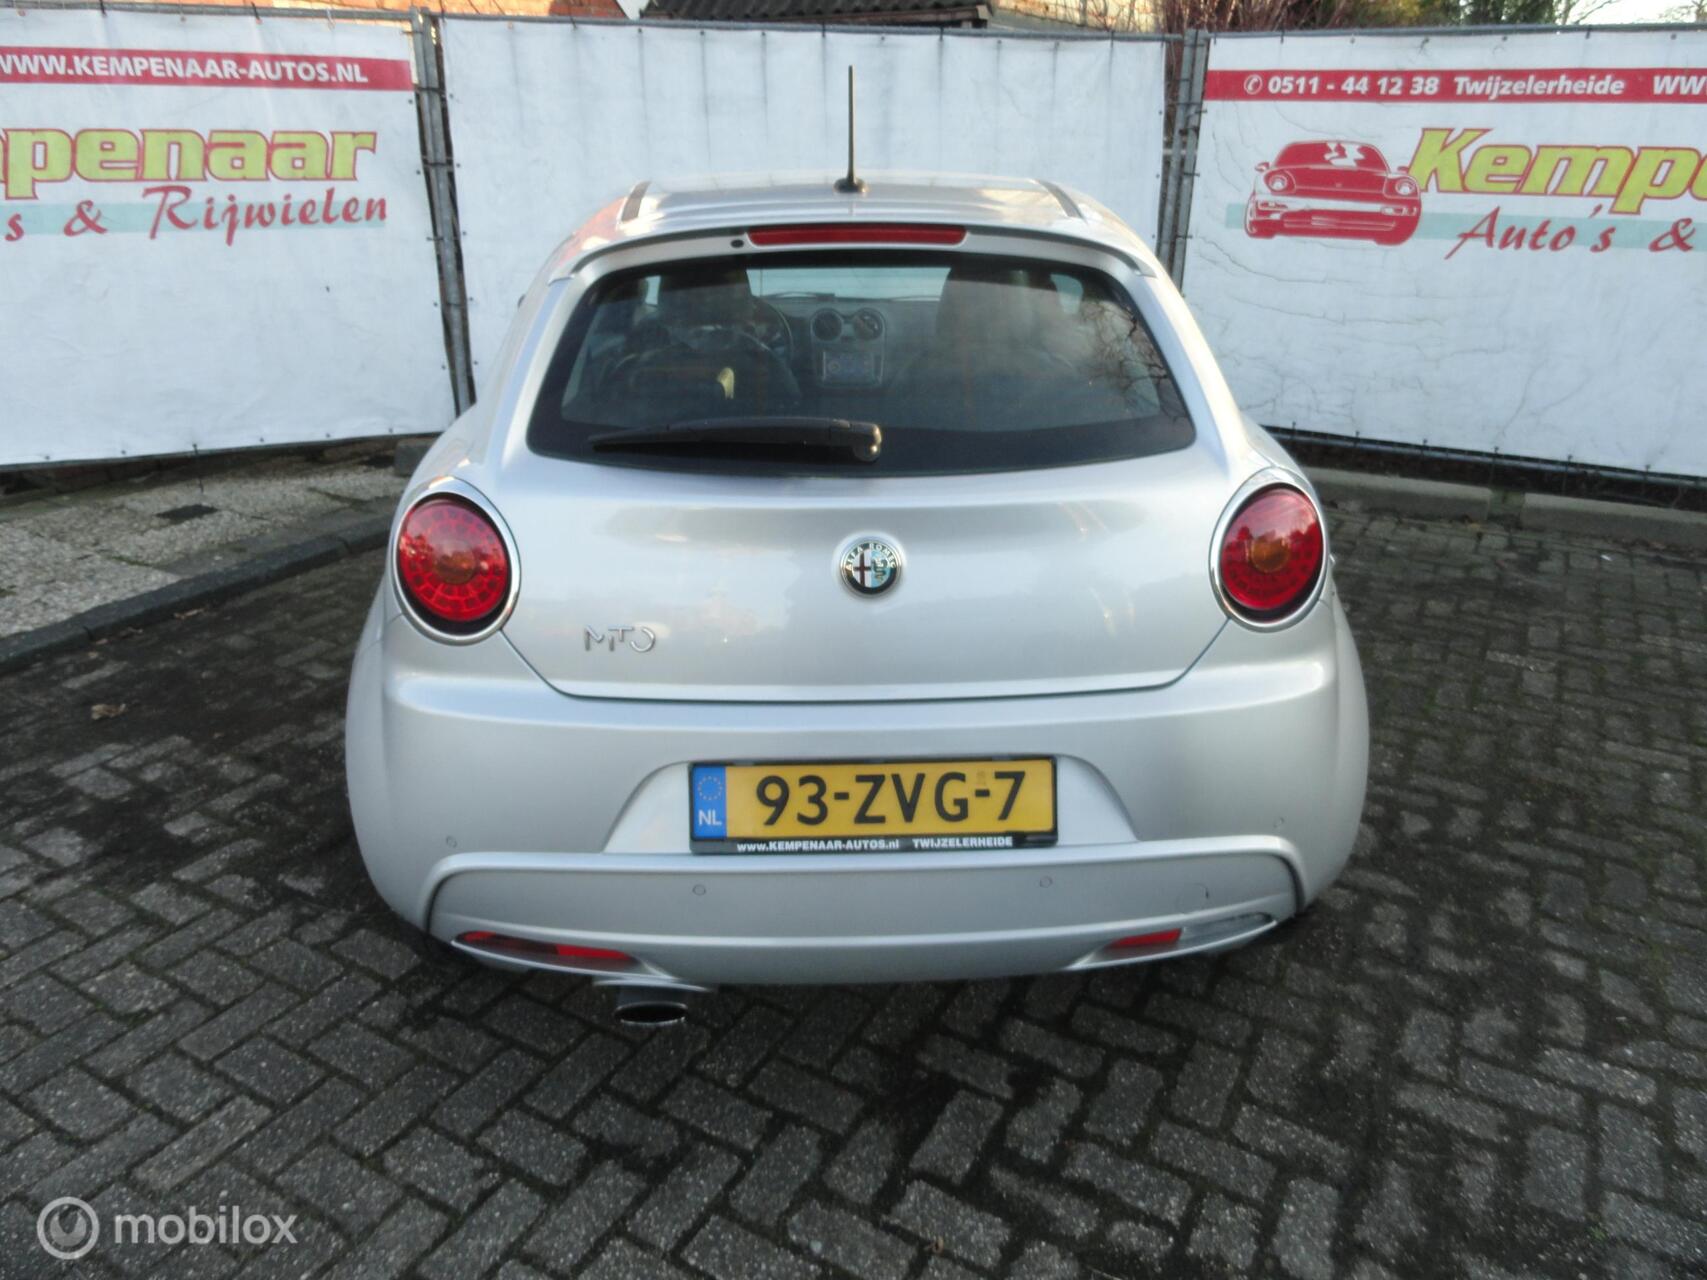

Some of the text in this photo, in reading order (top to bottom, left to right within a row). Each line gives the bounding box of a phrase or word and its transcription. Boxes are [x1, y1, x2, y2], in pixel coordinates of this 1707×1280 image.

[1267, 75, 1320, 95] 0511
[1341, 76, 1369, 95] 44
[1377, 76, 1403, 95] 12
[1409, 76, 1440, 95] 38
[1454, 75, 1626, 100] Twijzelerheide
[0, 127, 377, 200] penaar
[63, 200, 108, 237] &
[142, 184, 387, 247] Rijwielen
[1444, 205, 1696, 260] Auto's &
[698, 809, 723, 826] NL
[755, 770, 1027, 826] 93-ZVG-7
[736, 836, 1014, 853] www.KEMPENAAR-AUTOS.nl TWIJZELERHEIDE
